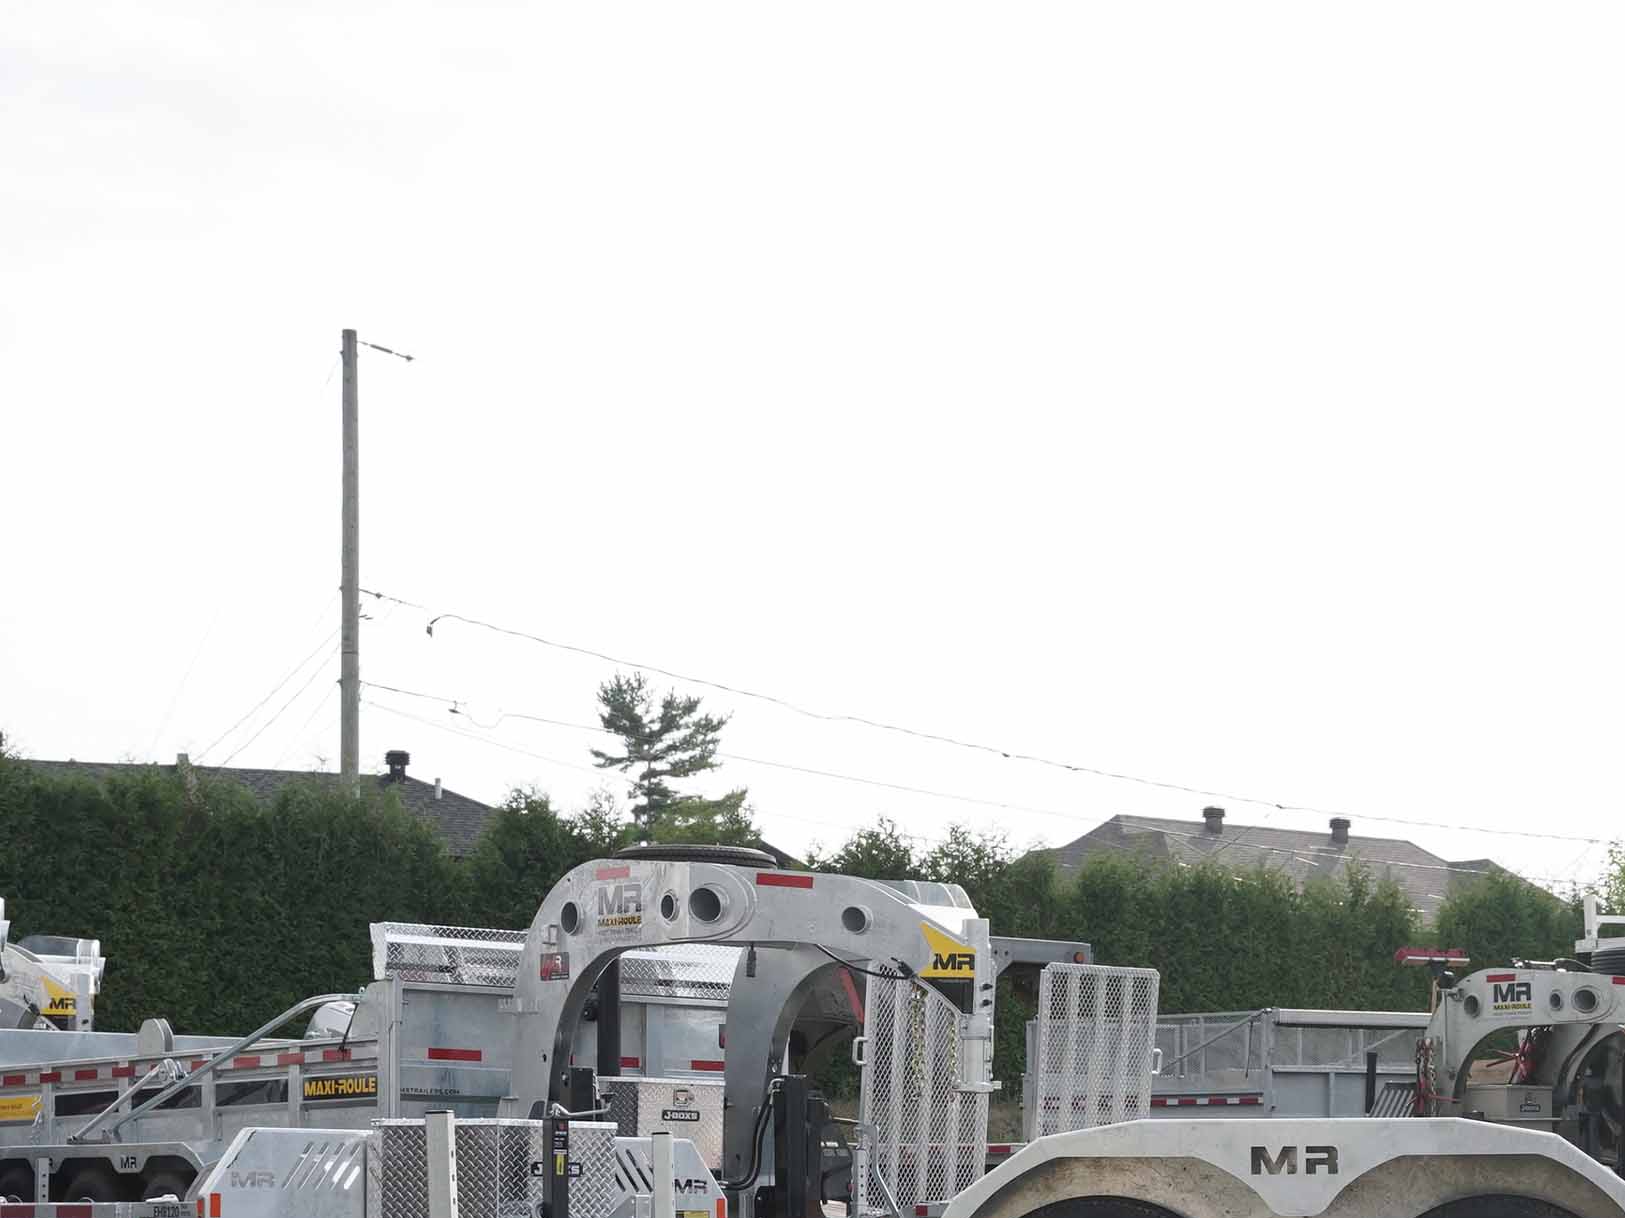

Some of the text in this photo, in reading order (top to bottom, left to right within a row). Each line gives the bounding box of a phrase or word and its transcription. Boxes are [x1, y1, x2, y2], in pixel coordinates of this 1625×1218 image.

[932, 953, 975, 970] MR
[1494, 983, 1531, 1002] MR
[48, 997, 76, 1010] MR
[304, 1077, 376, 1096] MAXI-ROULE
[120, 1155, 137, 1169] MR
[1250, 1146, 1338, 1175] MR
